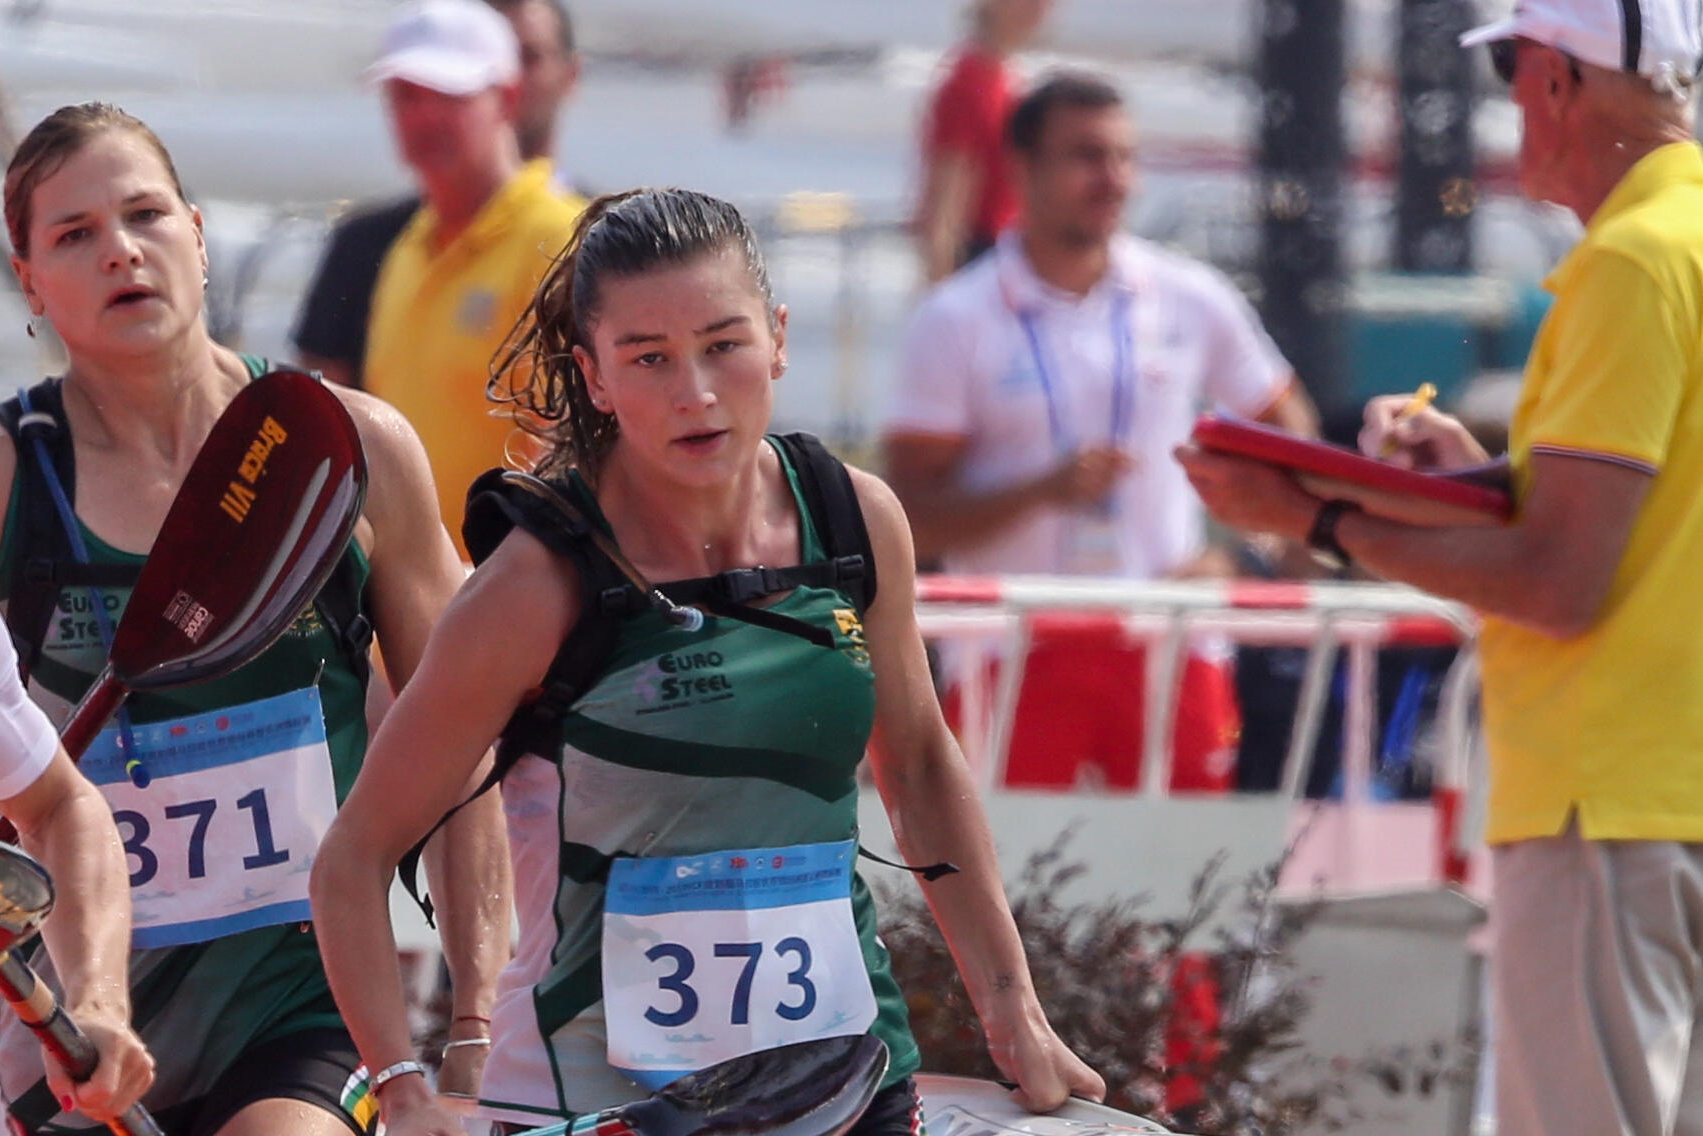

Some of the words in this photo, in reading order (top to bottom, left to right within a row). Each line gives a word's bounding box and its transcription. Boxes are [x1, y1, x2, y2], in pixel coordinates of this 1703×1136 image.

[219, 481, 256, 524] VII
[113, 788, 290, 888] 371
[644, 936, 817, 1028] 373
